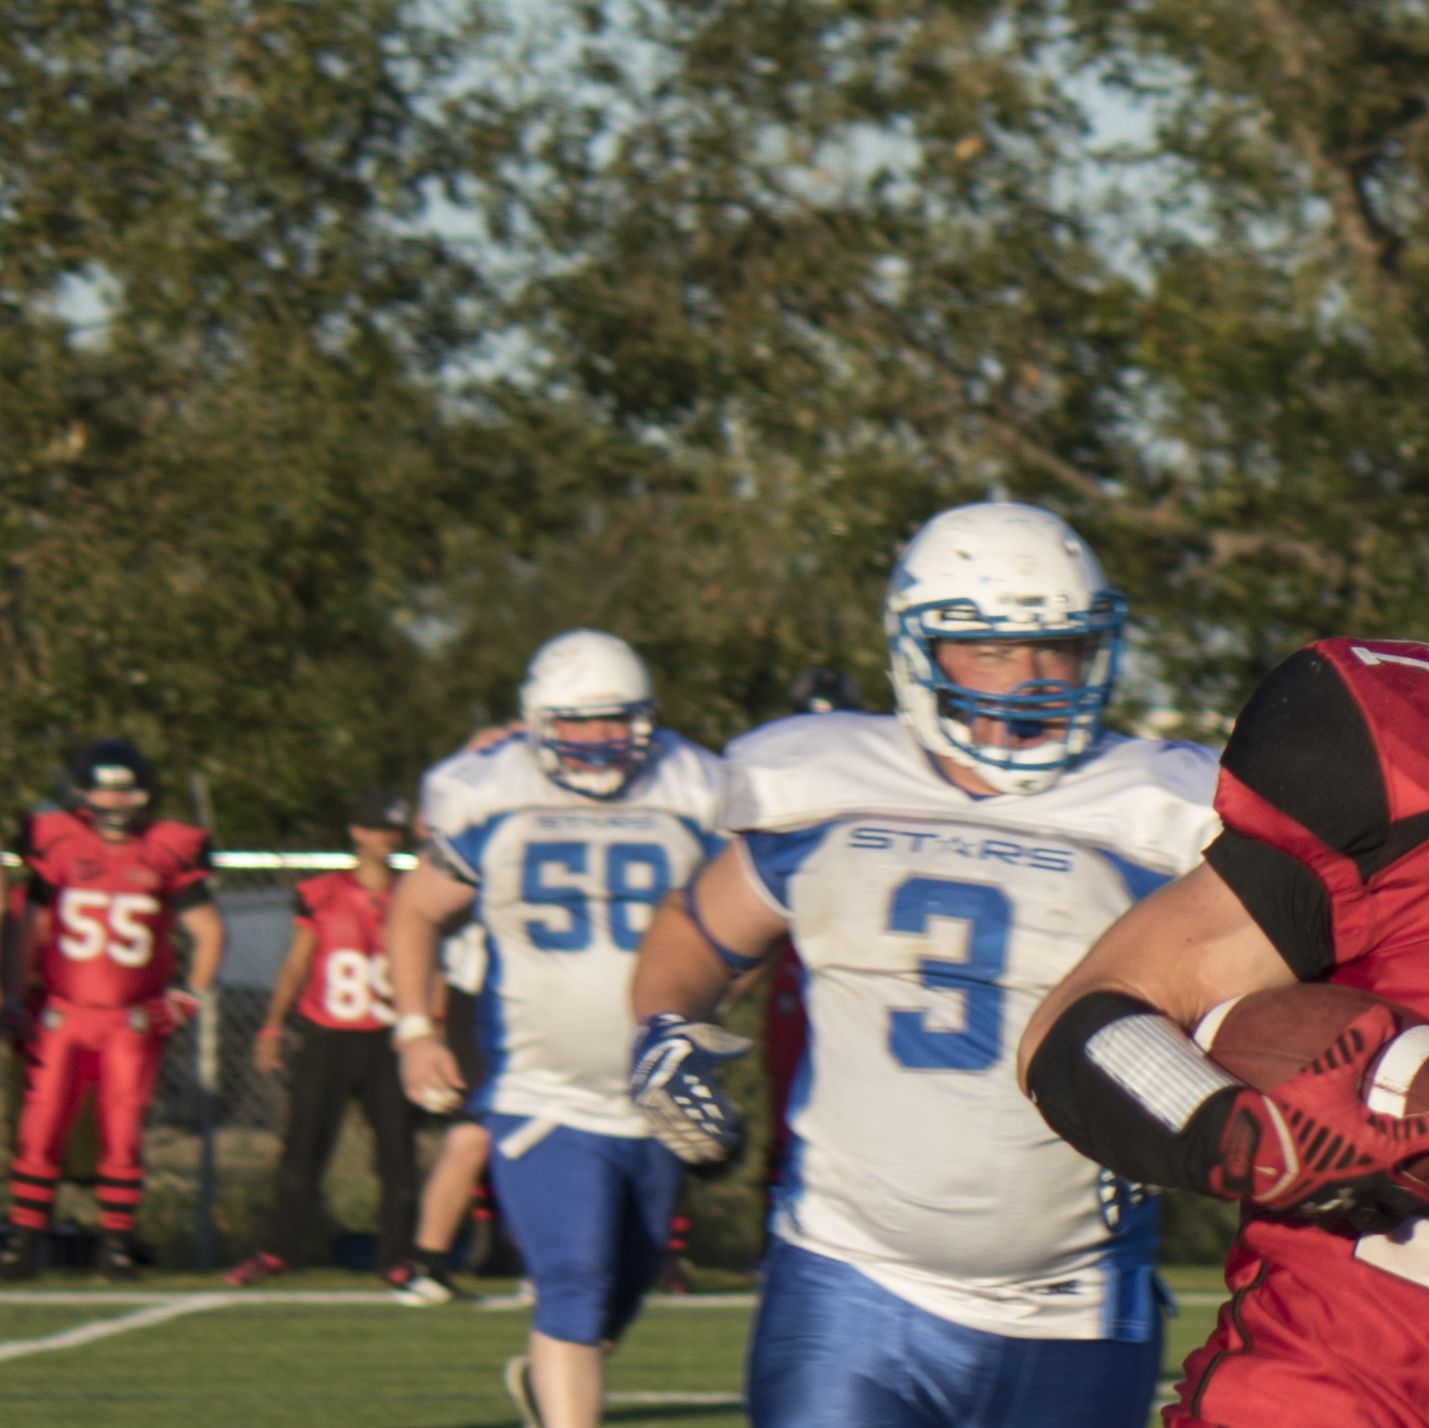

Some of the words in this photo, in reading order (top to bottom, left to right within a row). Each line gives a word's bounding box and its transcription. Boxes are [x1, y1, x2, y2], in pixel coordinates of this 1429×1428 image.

[849, 827, 1075, 873] STARS
[59, 887, 160, 968] 55
[884, 875, 1013, 1071] 3
